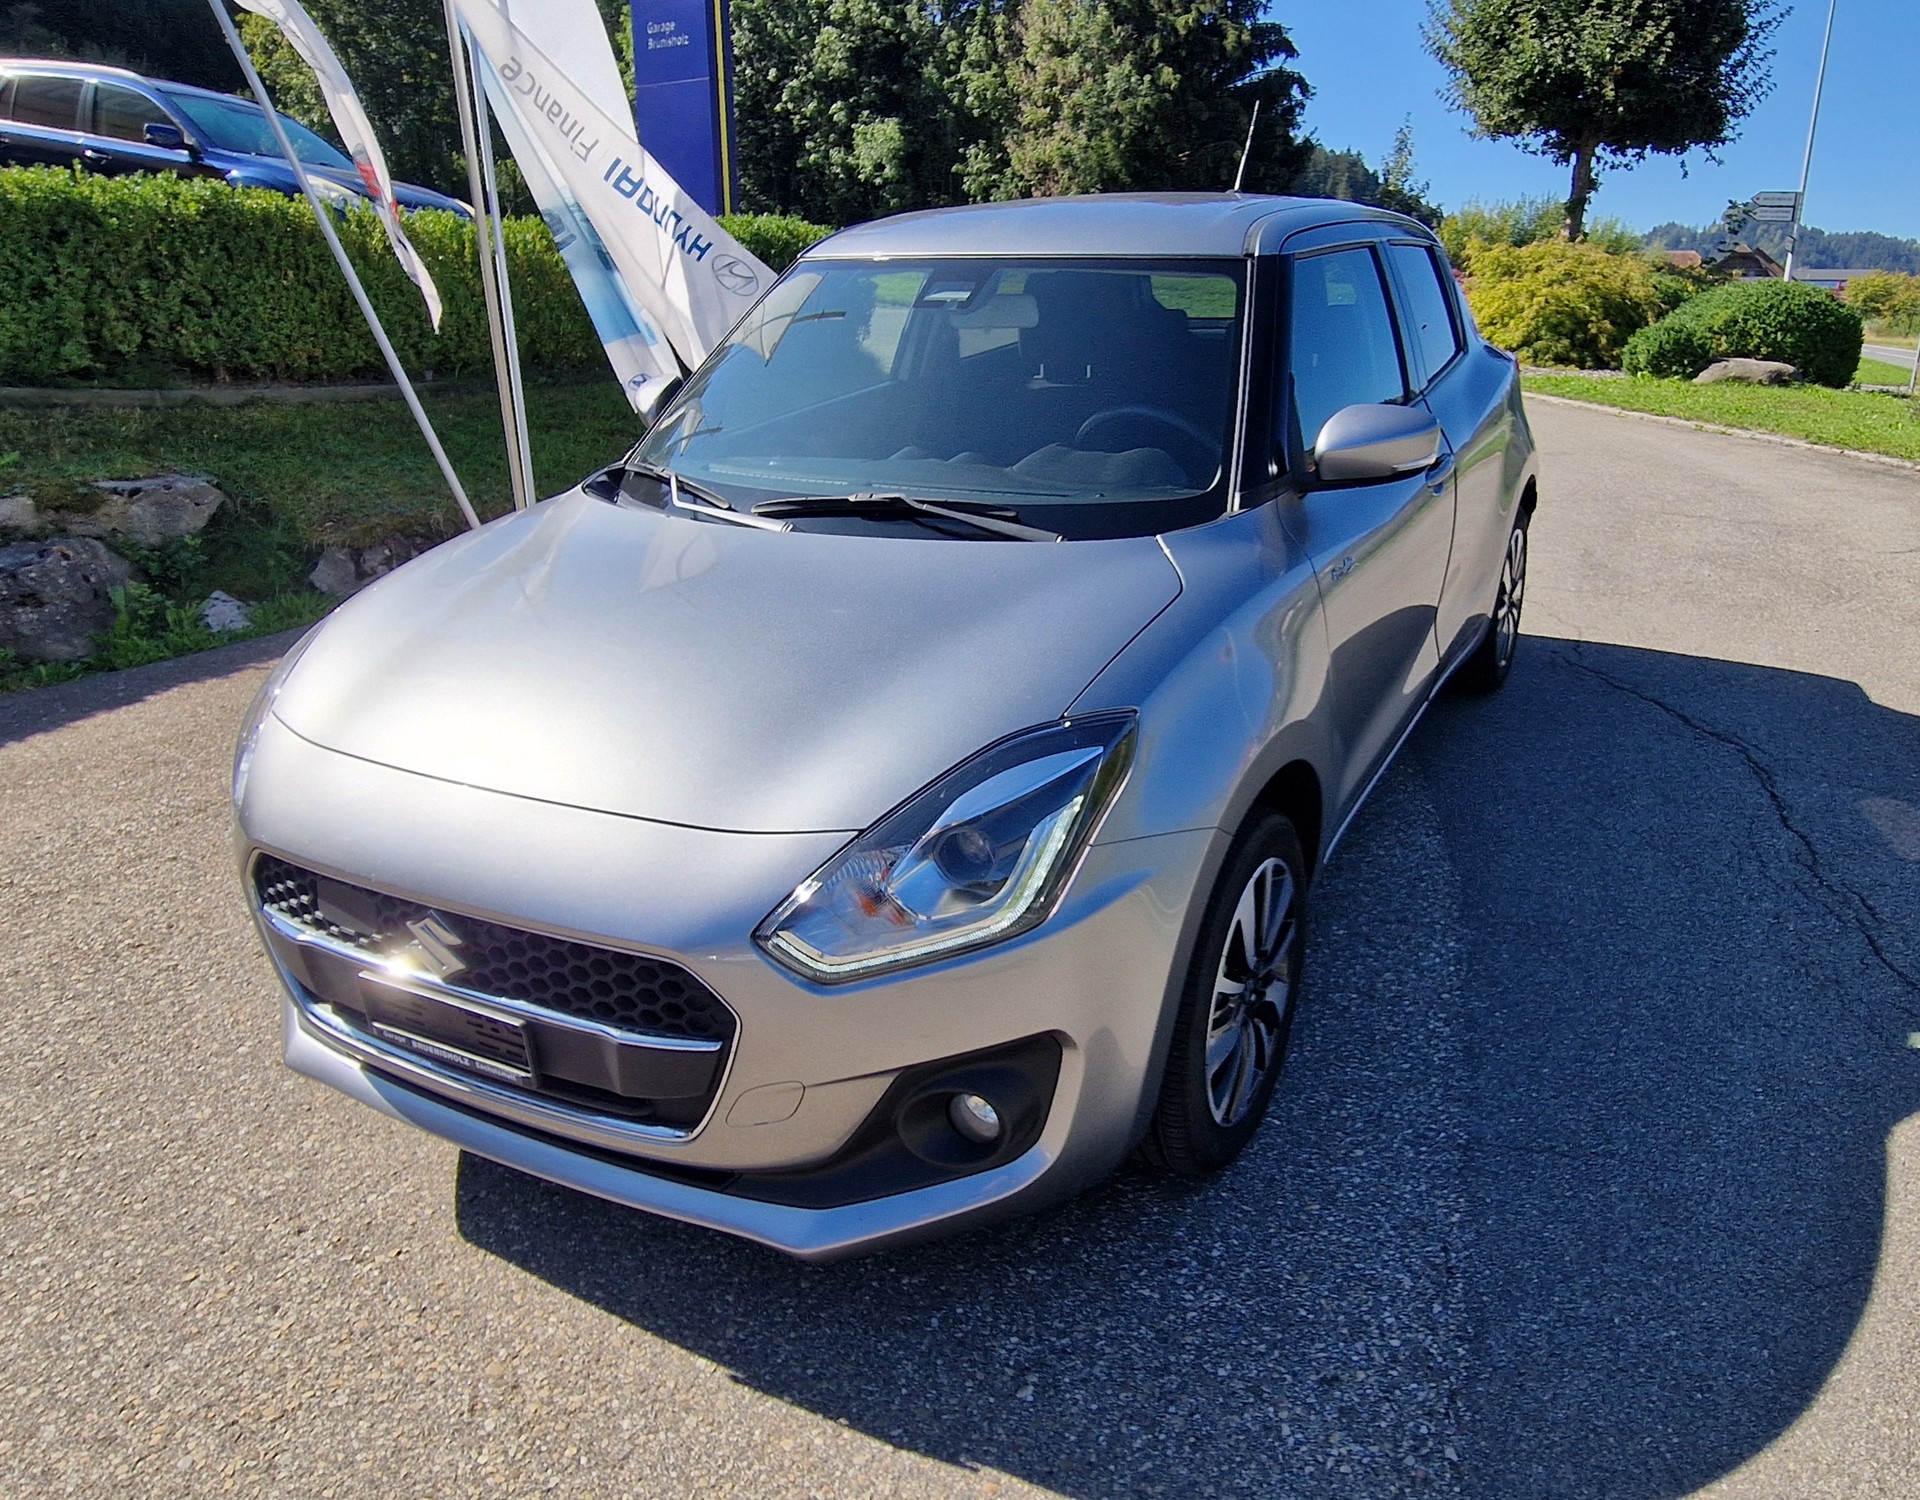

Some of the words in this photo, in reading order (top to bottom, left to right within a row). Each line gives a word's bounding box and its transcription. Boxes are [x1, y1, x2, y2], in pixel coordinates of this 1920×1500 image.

[647, 21, 675, 35] Garage
[500, 56, 599, 163] Finance
[603, 156, 714, 263] HYUNDAI
